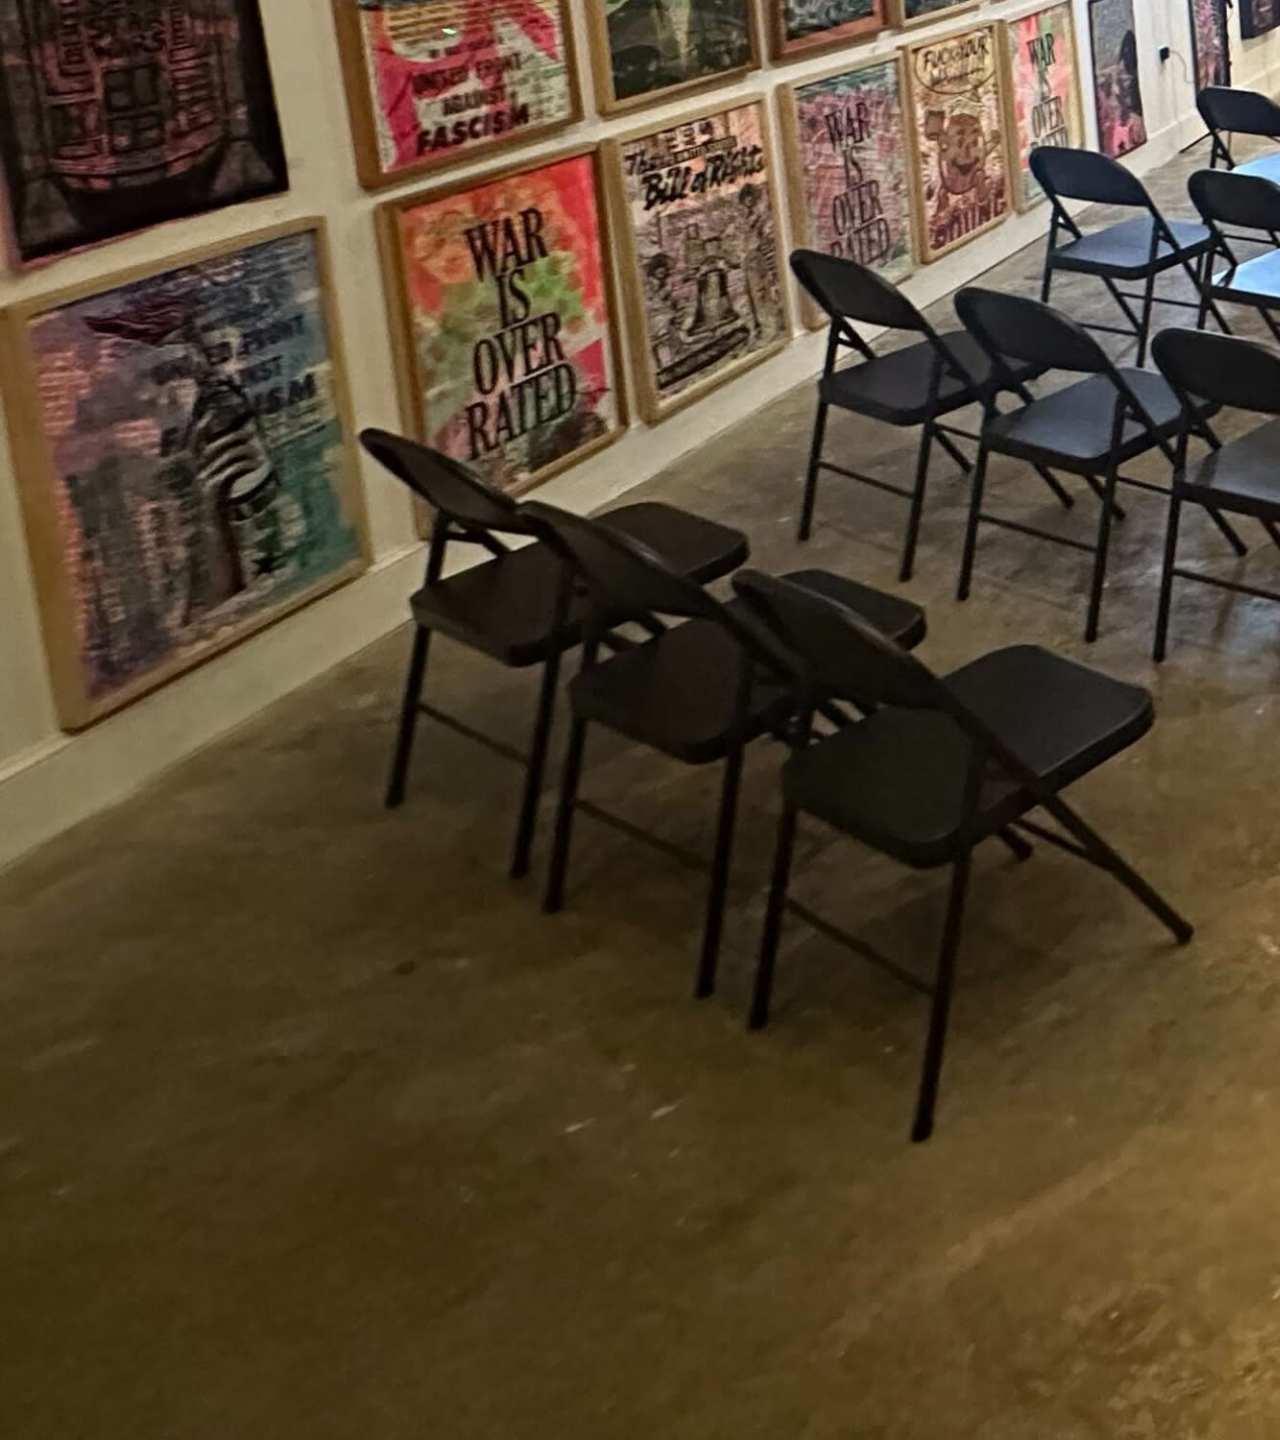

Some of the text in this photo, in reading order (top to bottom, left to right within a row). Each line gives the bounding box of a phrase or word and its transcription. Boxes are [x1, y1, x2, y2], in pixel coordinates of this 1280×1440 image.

[1026, 32, 1056, 66] WAR
[416, 102, 530, 157] FASCISM
[824, 101, 871, 153] WAR
[1031, 96, 1065, 139] OVER
[642, 165, 692, 211] Bill
[832, 179, 884, 236] OVER
[464, 207, 549, 283] WAR
[496, 268, 531, 329] IS
[473, 311, 568, 396] OVER
[465, 362, 576, 461] RATED
